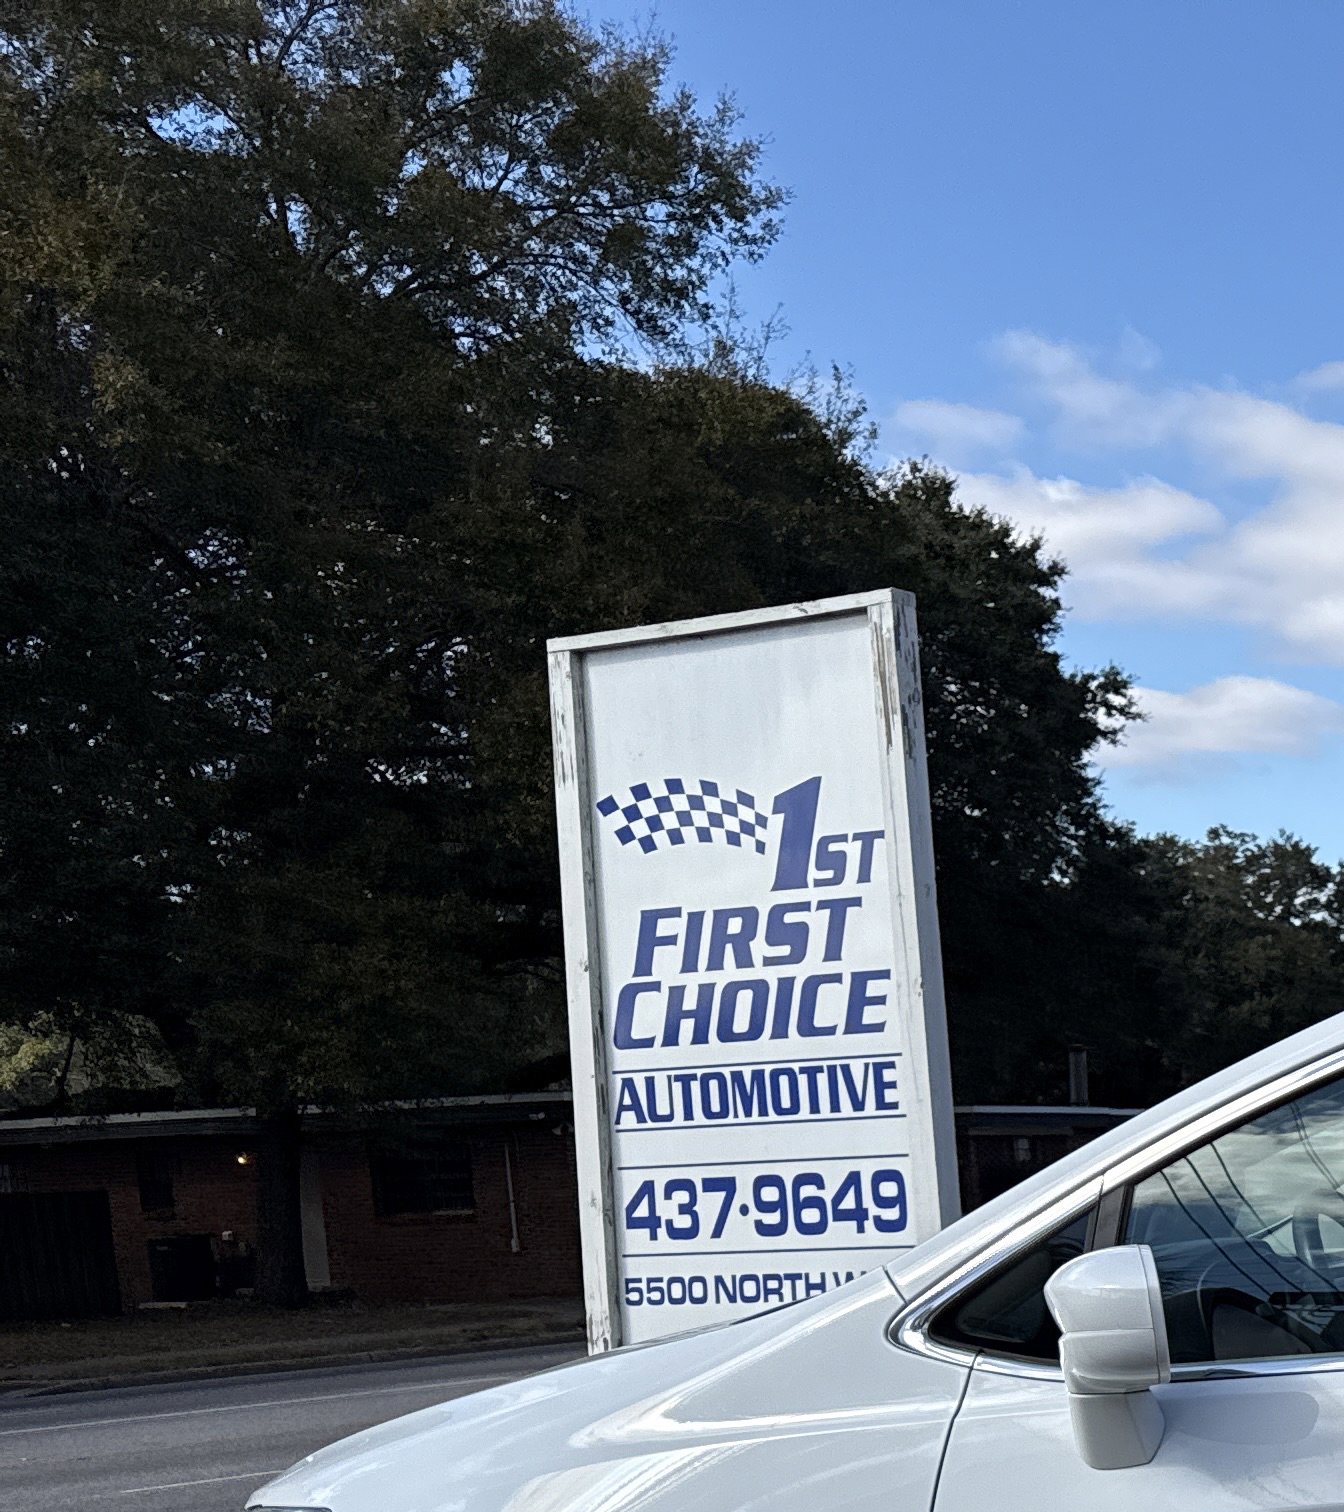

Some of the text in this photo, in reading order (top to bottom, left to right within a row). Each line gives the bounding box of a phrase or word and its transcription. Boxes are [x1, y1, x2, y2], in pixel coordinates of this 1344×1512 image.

[773, 776, 885, 891] 1ST
[631, 896, 862, 977] FIRST
[612, 969, 891, 1050] CHOICE
[614, 1060, 898, 1125] AUTOMOTIVE
[624, 1276, 708, 1306] 5500
[714, 1272, 827, 1304] NORTH
